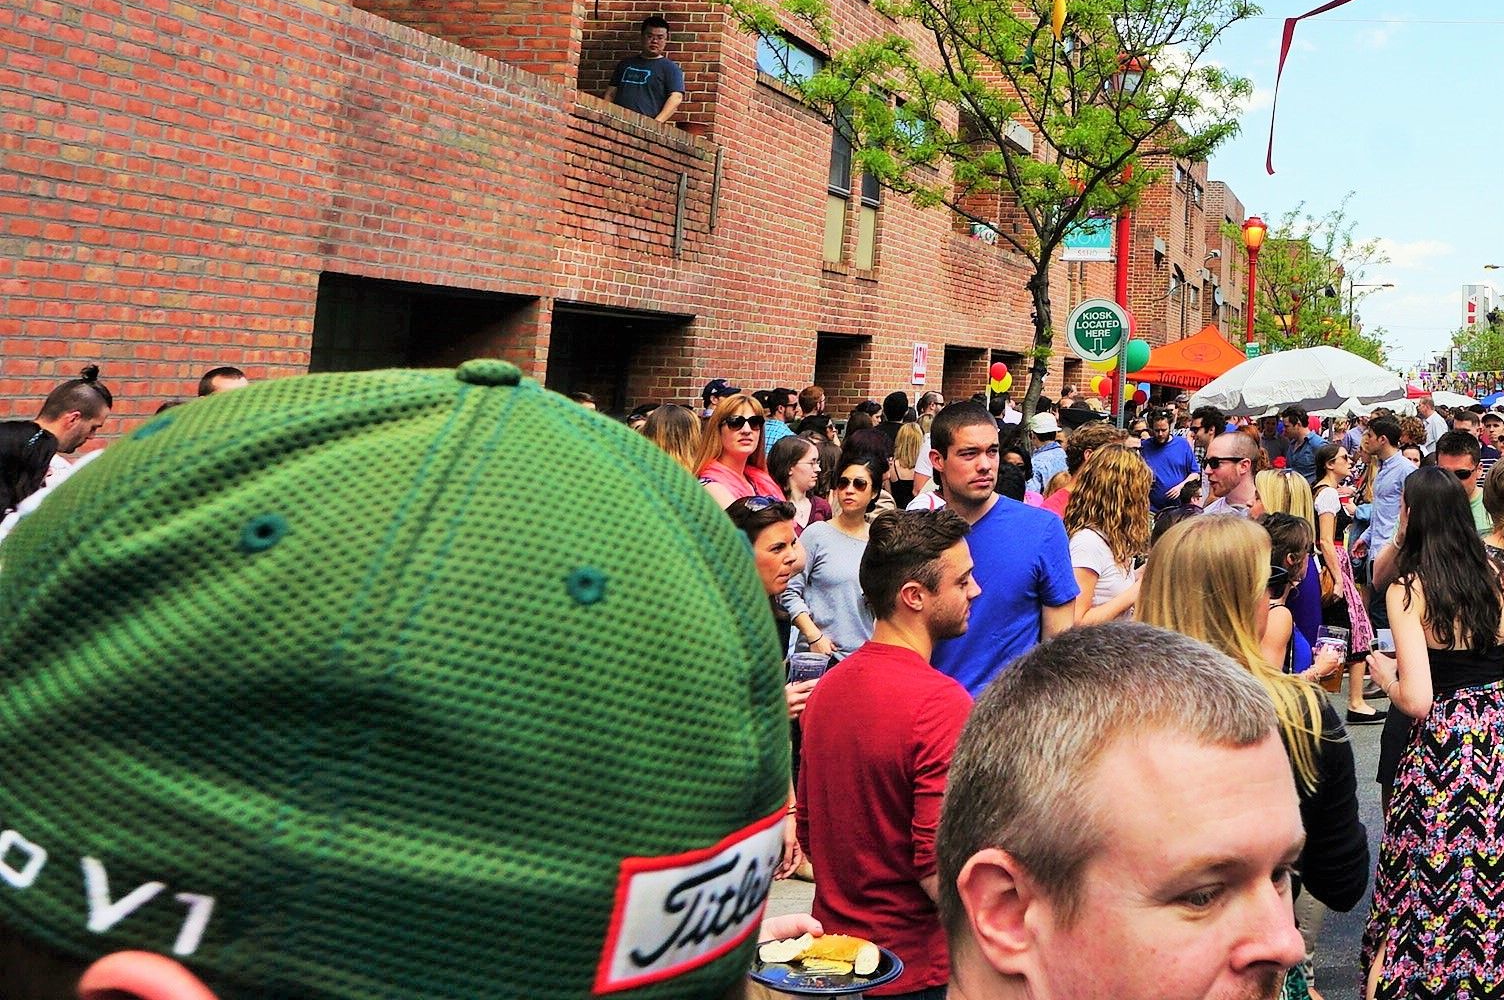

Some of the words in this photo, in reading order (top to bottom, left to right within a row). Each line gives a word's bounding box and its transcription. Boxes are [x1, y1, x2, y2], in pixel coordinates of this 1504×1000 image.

[1082, 312, 1113, 320] KIOSK
[1076, 320, 1120, 329] LOCATED
[1085, 329, 1111, 338] HERE
